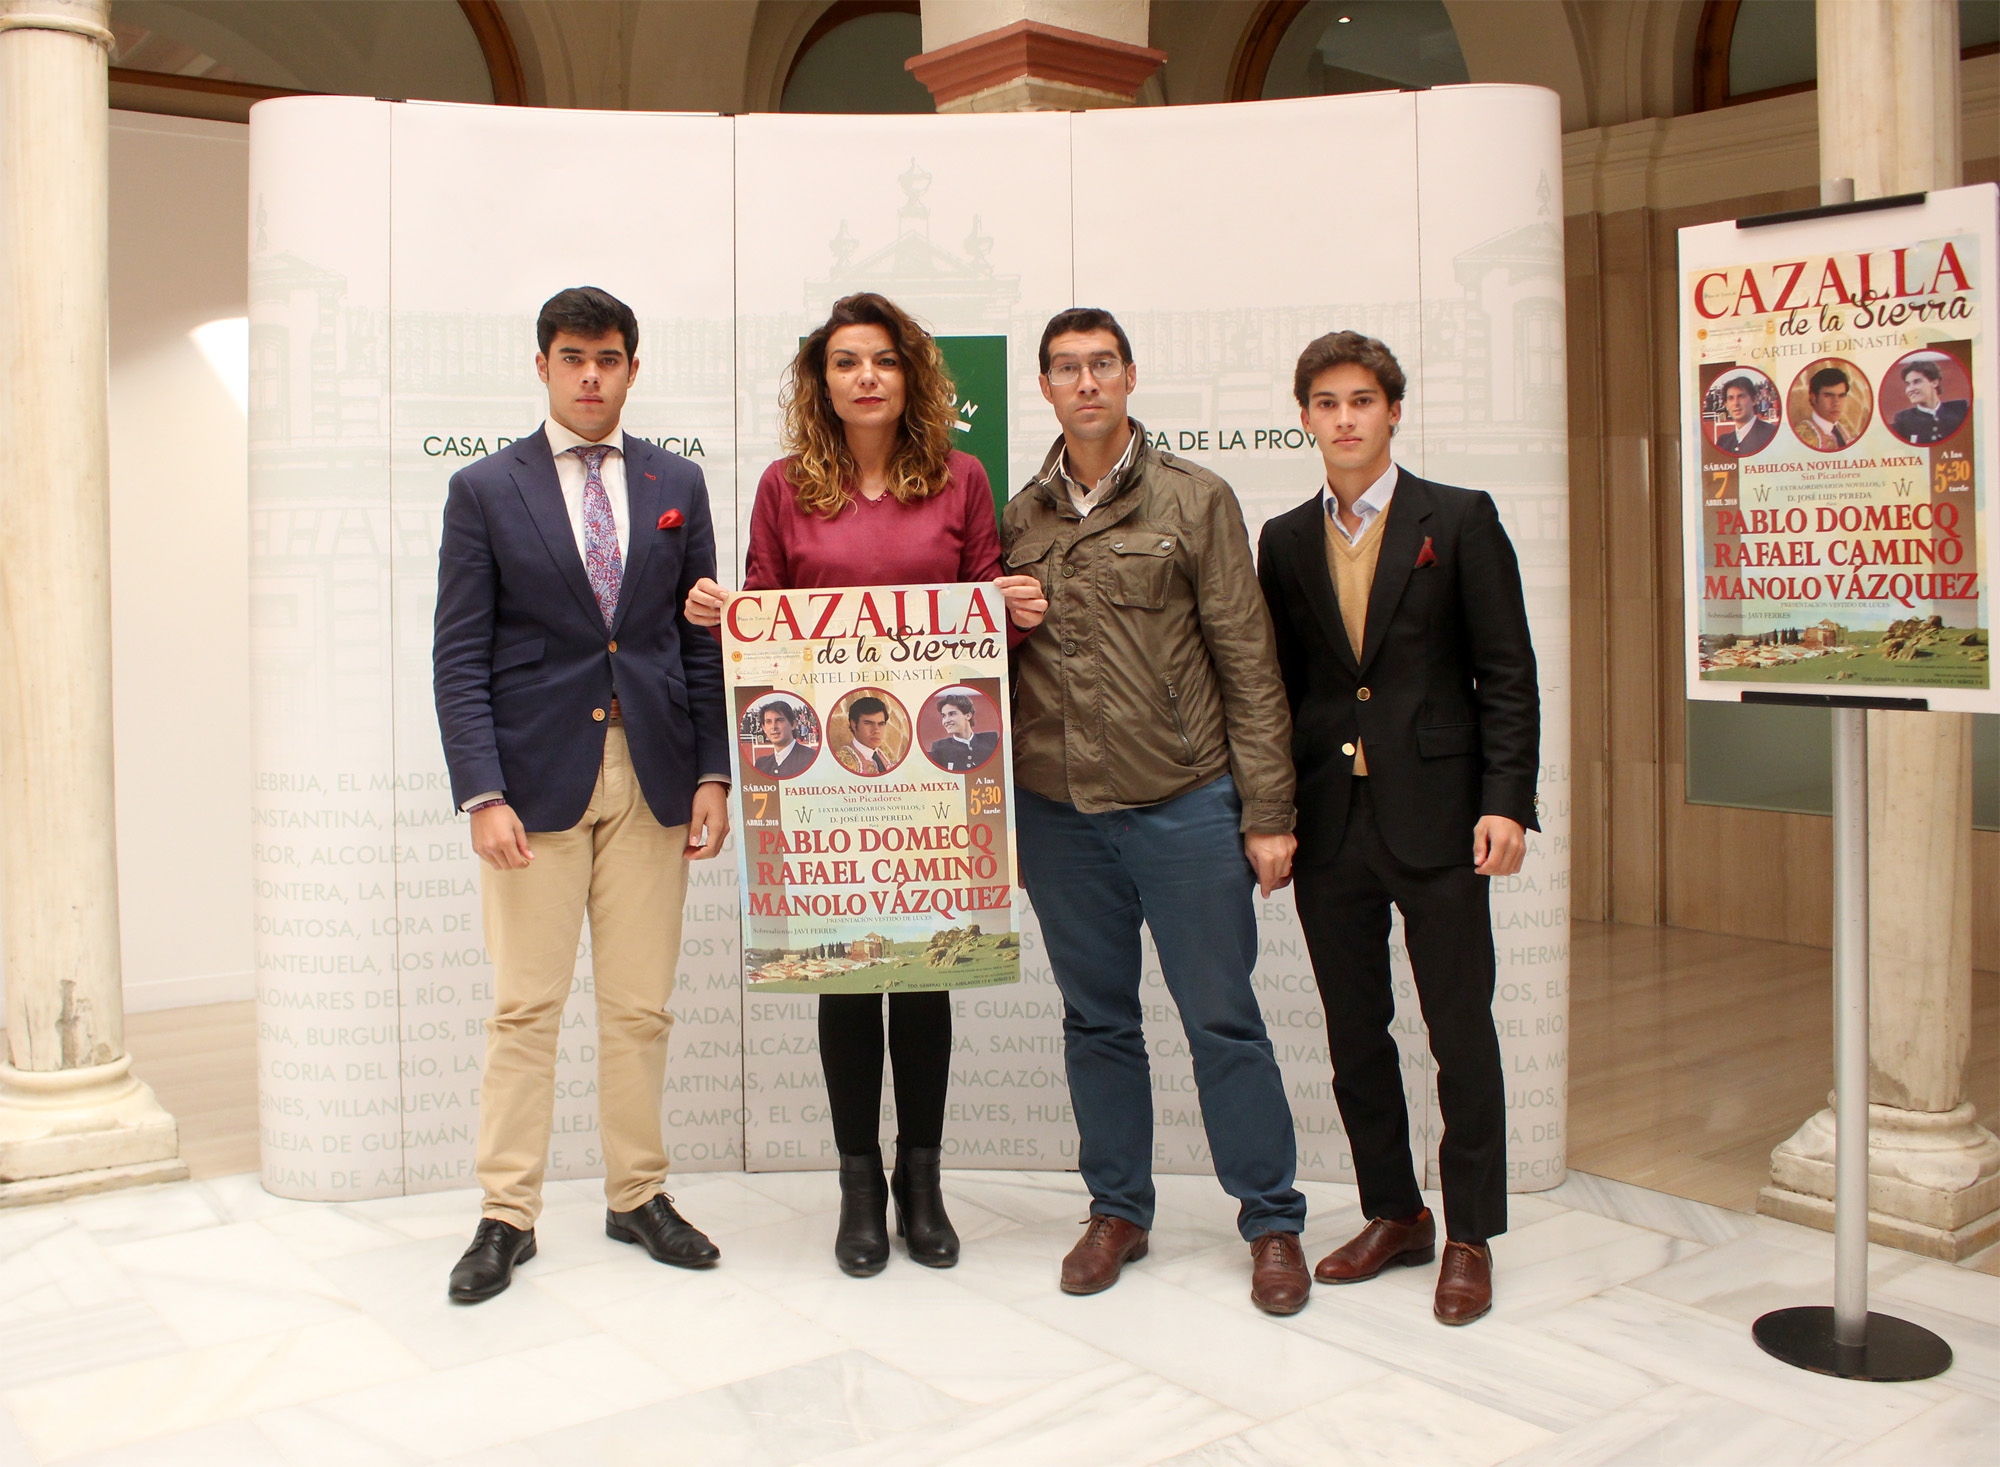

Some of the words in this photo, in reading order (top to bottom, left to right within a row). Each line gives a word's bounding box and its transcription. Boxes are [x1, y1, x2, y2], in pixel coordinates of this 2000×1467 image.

[1694, 242, 1974, 319] CAZALLA
[1780, 307, 1812, 336] de
[1820, 304, 1843, 331] la
[1851, 289, 1973, 329] Sierra
[1751, 346, 1807, 359] CARTEL
[1812, 343, 1831, 354] DE
[1837, 334, 1908, 351] DINASTÍA
[423, 436, 489, 457] CASA
[1179, 431, 1209, 451] DE
[1219, 430, 1247, 450] LA
[1703, 462, 1737, 472] SÁBADO
[1744, 463, 1803, 474] FABULOSA
[1807, 459, 1877, 471] NOVILLADA
[1881, 456, 1923, 467] MIXTA
[1801, 473, 1815, 481] Sin
[1817, 471, 1860, 480] Picadores
[1934, 460, 1971, 493] 5:30
[1713, 471, 1729, 499] 7
[1797, 492, 1817, 503] JOSÉ
[1839, 491, 1872, 500] PEREDA
[1716, 507, 1807, 535] PABLO
[1816, 502, 1961, 538] DOMECQ
[1714, 541, 1821, 568] RAFAEL
[1828, 537, 1963, 566] CAMINO
[1703, 576, 1822, 600] MANOLO
[1825, 565, 1979, 608] VÁZQUEZ
[727, 587, 1000, 642] CAZALLA
[817, 637, 849, 664] de
[857, 635, 881, 663] la
[887, 624, 1000, 662] Sierra
[789, 672, 844, 685] CARTEL
[850, 670, 869, 682] DE
[874, 665, 943, 682] DINASTÍA
[338, 773, 361, 792] EL
[743, 783, 777, 792] SÁBADO
[785, 785, 845, 796] FABULOSA
[848, 783, 916, 795] NOVILLADA
[920, 781, 959, 793] MIXTA
[975, 777, 983, 785] A
[752, 793, 768, 819] 7
[822, 805, 886, 813] EXTRAORDINARIOS
[860, 795, 902, 803] Picadores
[970, 786, 1002, 815] 5:30
[983, 807, 1001, 815] tarde
[746, 819, 765, 827] ABRIL
[765, 819, 779, 827] 2018
[840, 814, 859, 824] JOSÉ
[757, 828, 851, 854] PABLO
[858, 824, 995, 856] DOMECQ
[310, 844, 419, 866] ALCOLEA
[427, 842, 470, 861] DEL
[757, 860, 864, 886] RAFAEL
[872, 855, 997, 884] CAMINO
[359, 883, 385, 900] LA
[395, 878, 478, 900] PUEBLA
[748, 892, 867, 917] MANOLO
[869, 880, 1011, 919] VÁZQUEZ
[371, 917, 433, 937] LORA
[442, 913, 472, 933] DE
[794, 927, 810, 935] JAVI
[811, 927, 837, 935] FERRES
[390, 952, 434, 973] LOS
[364, 989, 408, 1010] DEL
[416, 981, 462, 1007] RÍO,
[472, 982, 494, 1002] EL
[306, 1020, 457, 1047] BURGUILLOS,
[271, 1060, 337, 1082] CORIA
[345, 1061, 388, 1082] DEL
[400, 1054, 443, 1079] RÍO,
[453, 1054, 480, 1073] LA
[1515, 1054, 1539, 1074] LA
[319, 1090, 461, 1118] VILLANUEVA
[664, 1071, 761, 1094] ARTINAS,
[322, 1134, 352, 1154] DE
[361, 1122, 475, 1153] GUZMÁN,
[667, 1106, 759, 1129] CAMPO,
[769, 1105, 796, 1124] EL
[268, 1165, 317, 1189] JUAN
[330, 1171, 361, 1190] DE
[766, 1140, 807, 1159] DEL
[944, 1137, 1045, 1160] OMARES,
